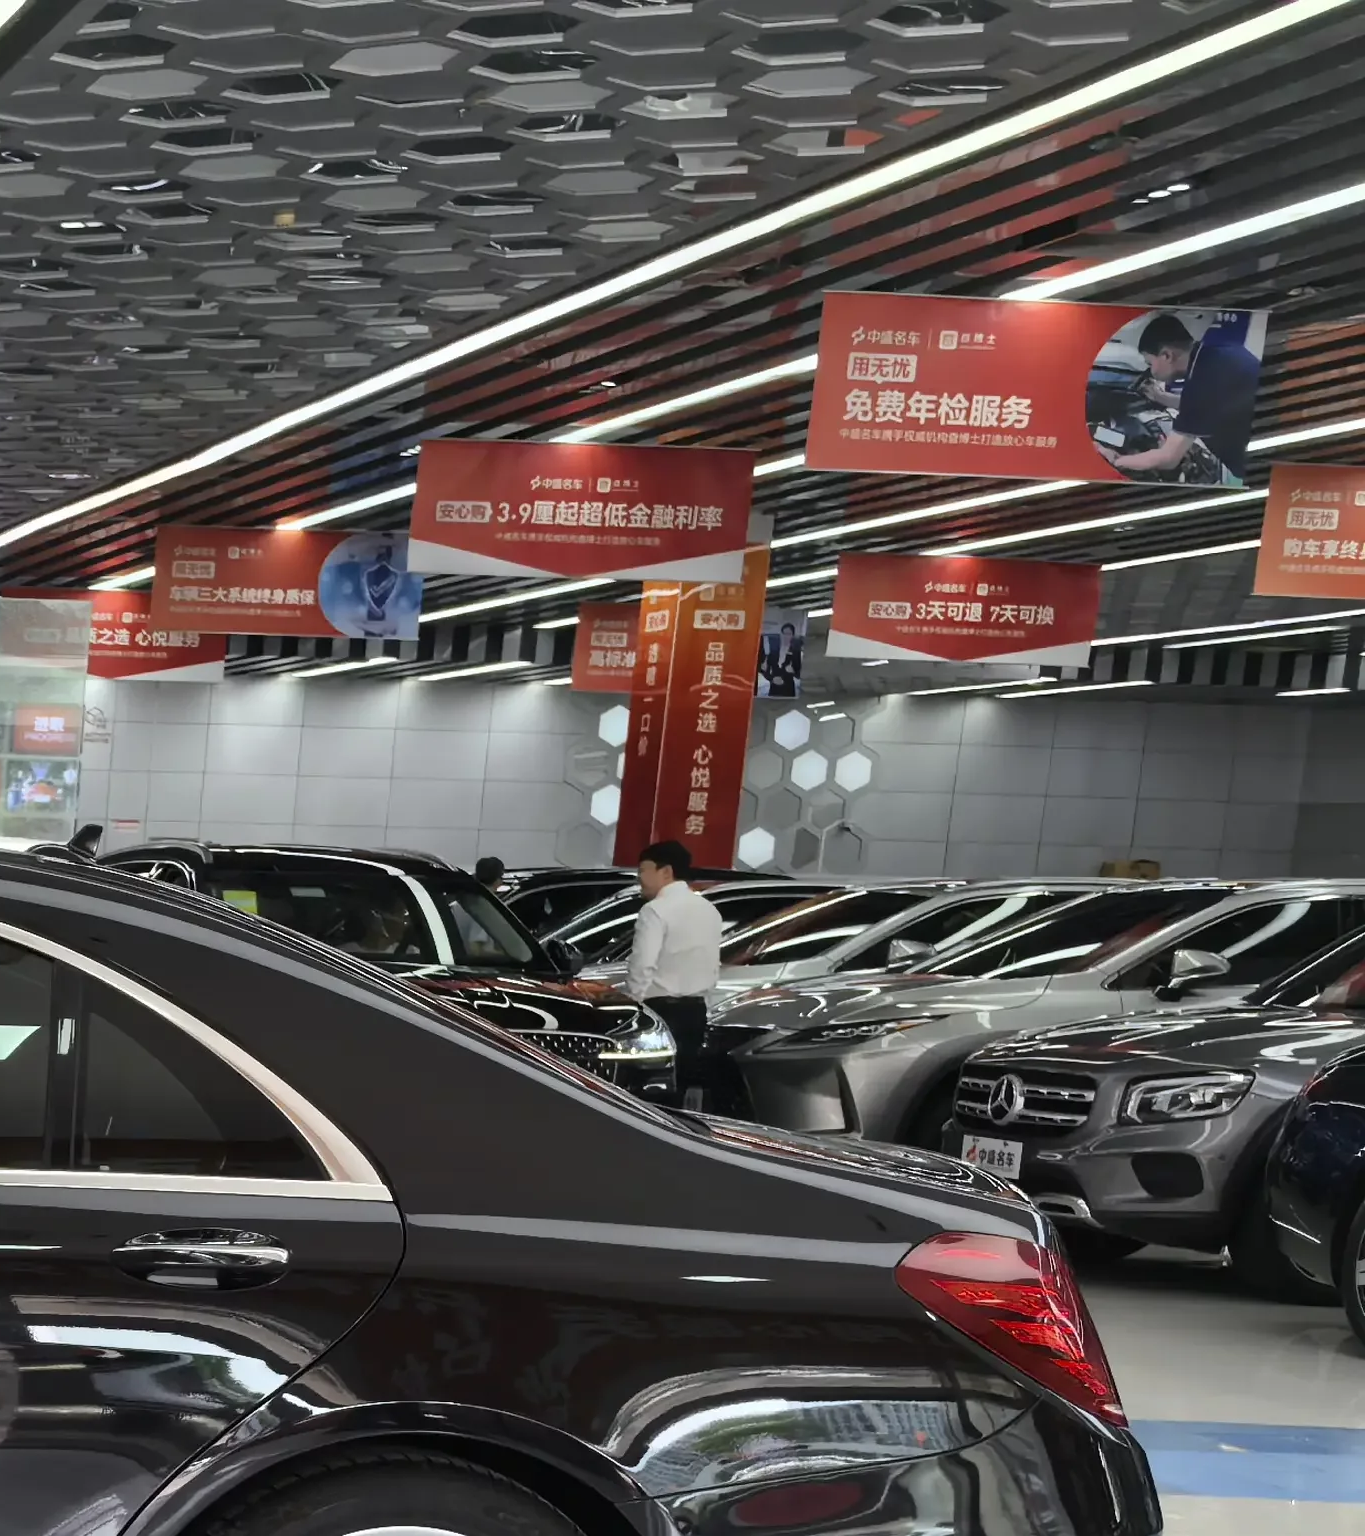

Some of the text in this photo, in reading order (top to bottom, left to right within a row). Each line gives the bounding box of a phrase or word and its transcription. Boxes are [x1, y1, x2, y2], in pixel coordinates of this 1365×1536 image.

[867, 328, 922, 347] 中盛名车
[850, 357, 912, 379] 用无忧
[842, 388, 1033, 429] 免费年检服务
[496, 500, 724, 531] 3.9厘起超低金融利率
[1289, 511, 1335, 527] 用无忧
[700, 612, 740, 627] 安心购
[915, 601, 983, 623] 3天可退
[990, 604, 1055, 626] 7天可换
[696, 642, 725, 733] 品质之选
[685, 744, 713, 836] 心悦服务
